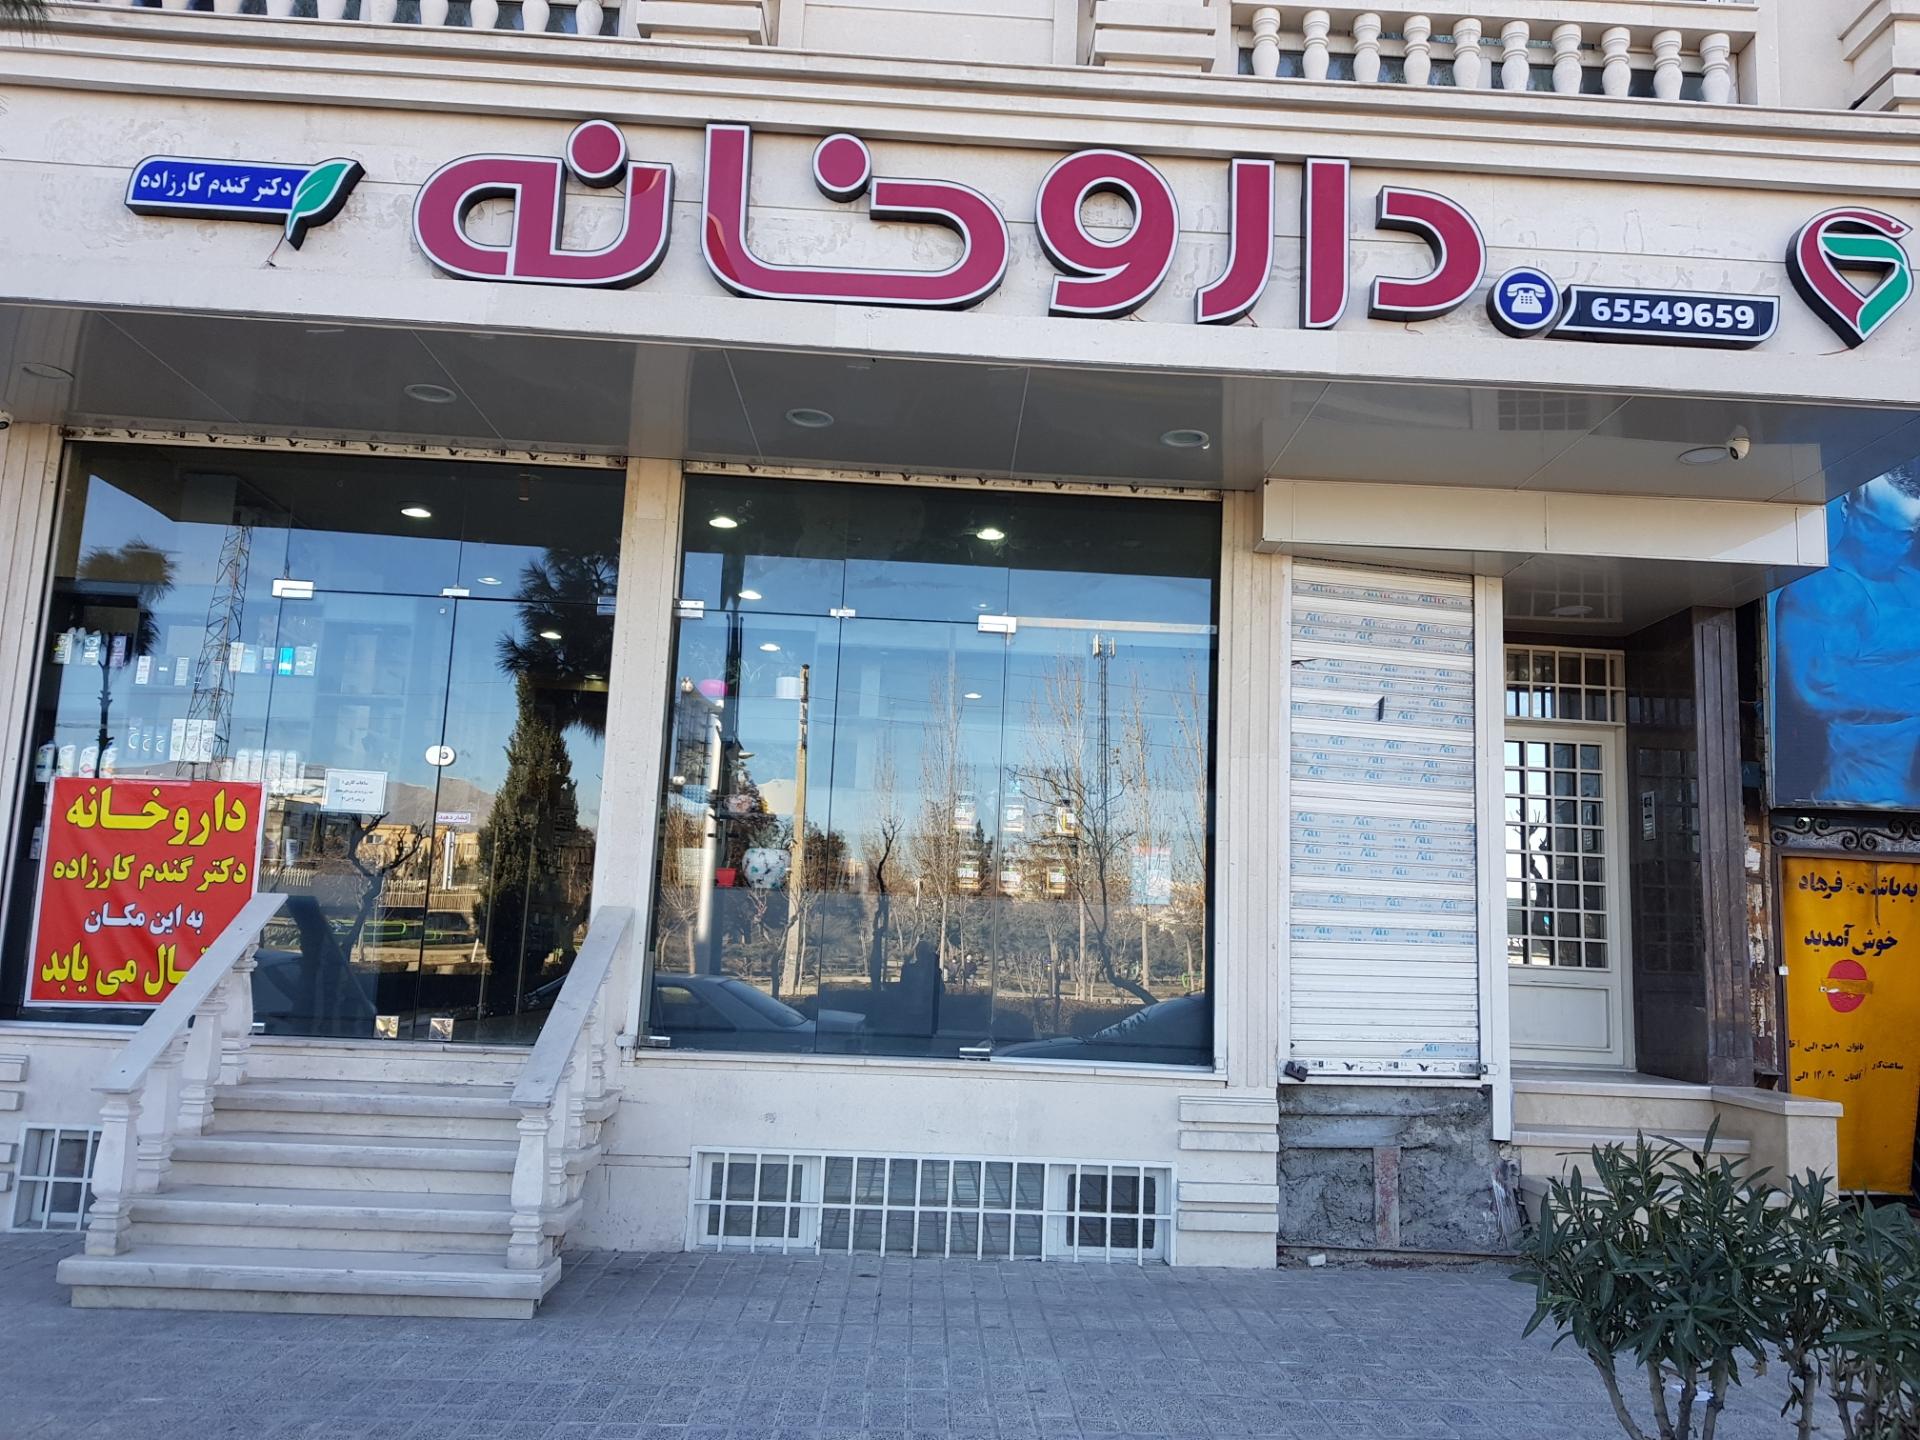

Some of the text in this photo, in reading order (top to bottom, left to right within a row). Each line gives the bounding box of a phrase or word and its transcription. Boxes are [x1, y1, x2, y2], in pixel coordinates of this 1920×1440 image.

[140, 170, 292, 202] دکتر گندم کارزاده
[413, 119, 1486, 329] داروخانه
[1591, 297, 1755, 330] 65549659
[65, 785, 248, 846] داروخانه
[52, 852, 248, 893] دکتر گندم کارزاده
[1902, 881, 1918, 903] به
[83, 902, 205, 935] به این مکان
[1804, 924, 1898, 957] خوش آمدید
[41, 941, 90, 993] یابد
[95, 958, 138, 997] می
